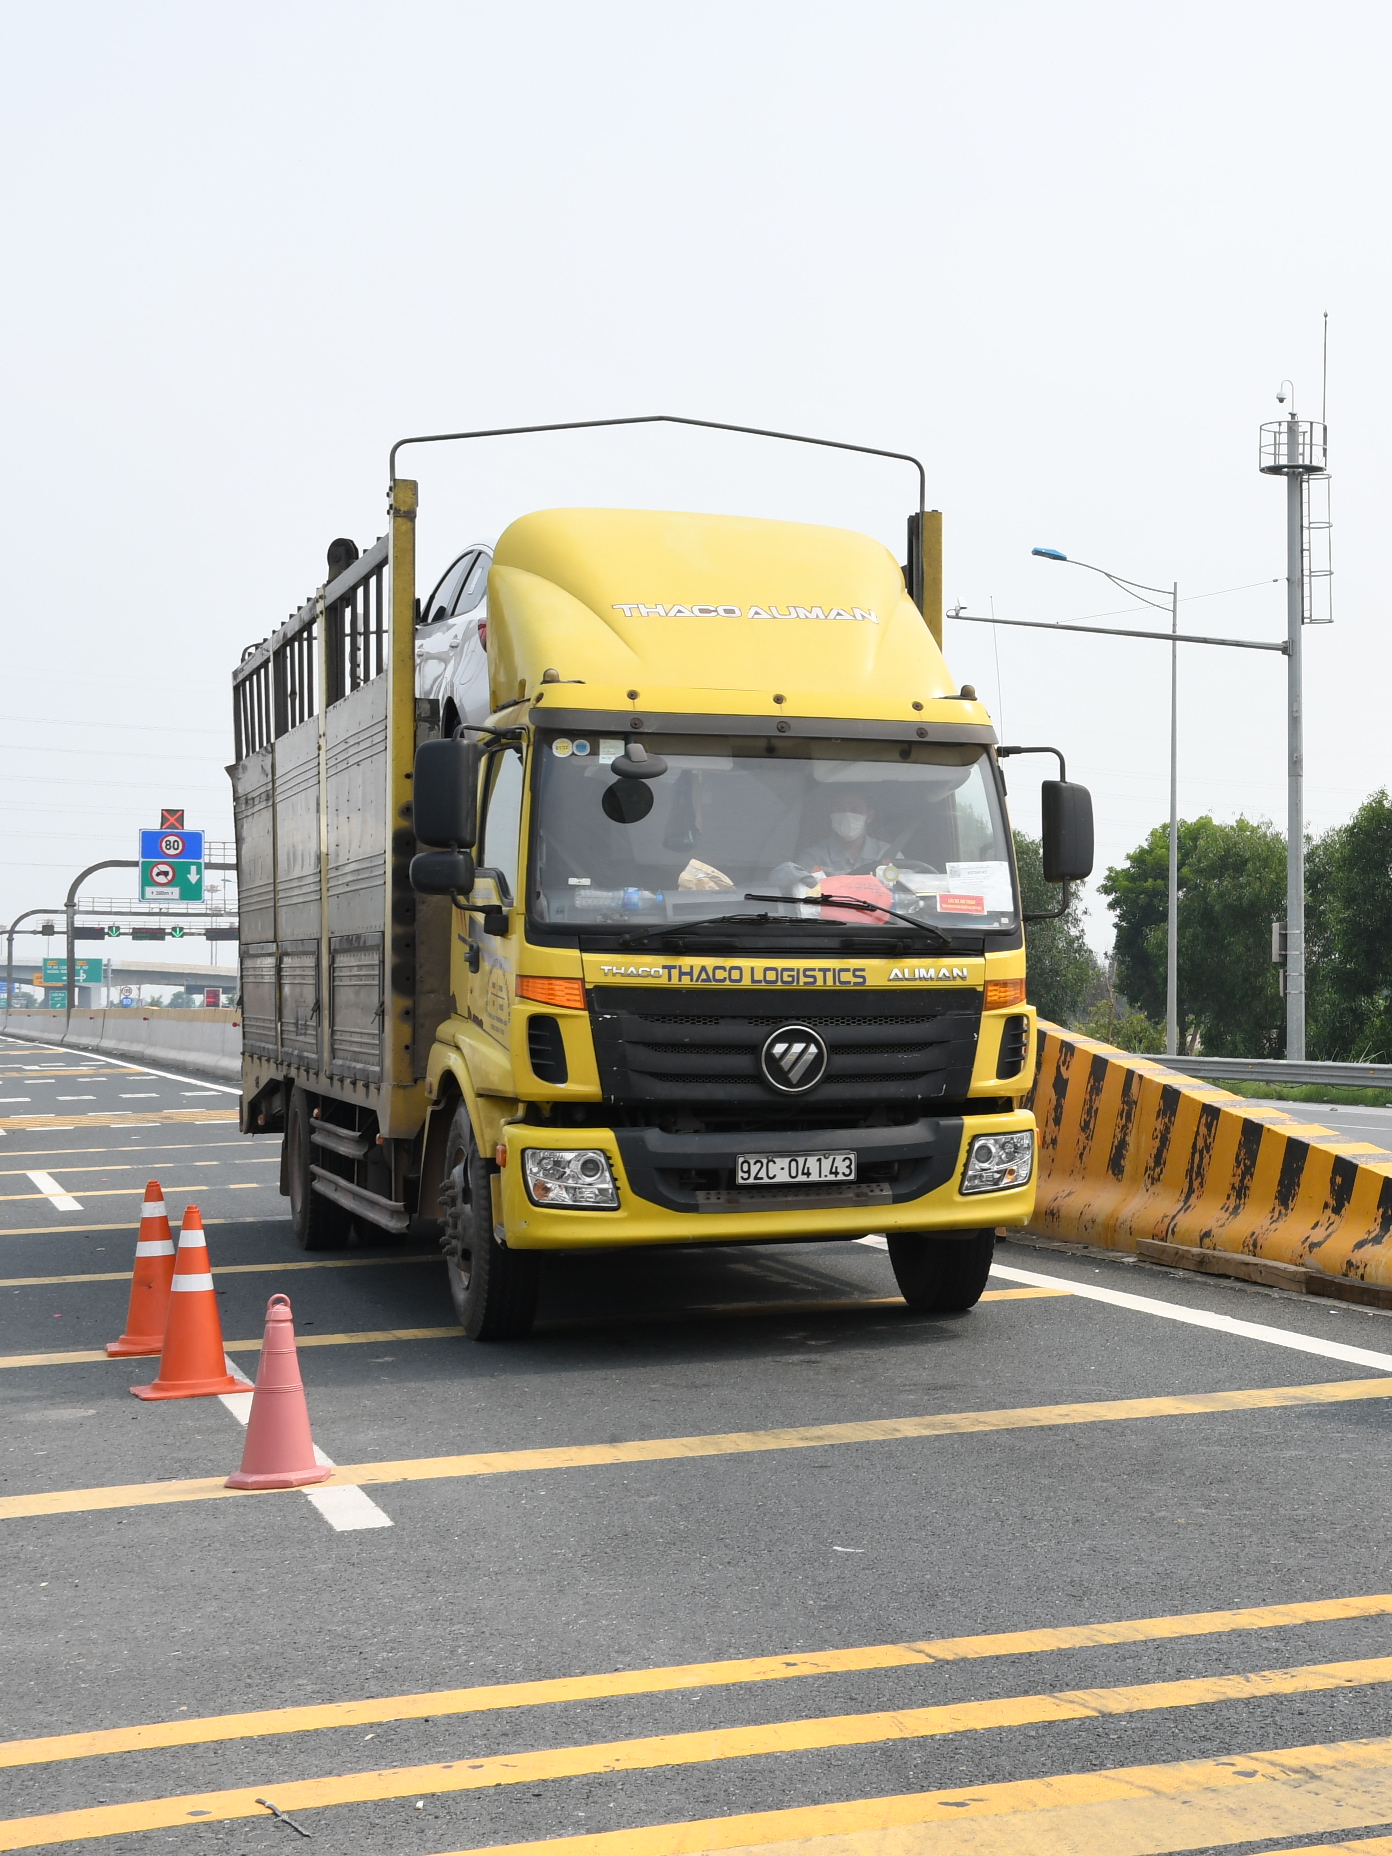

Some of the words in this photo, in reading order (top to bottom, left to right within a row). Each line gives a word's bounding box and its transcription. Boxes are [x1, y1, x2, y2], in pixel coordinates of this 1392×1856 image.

[612, 604, 742, 617] THACO
[747, 605, 879, 624] AUMAN
[164, 839, 180, 851] 80
[600, 965, 663, 978] THACO
[662, 965, 743, 983] THACO
[750, 966, 867, 985] LOGISTICS
[887, 967, 968, 982] AUMAN
[740, 1157, 853, 1181] 92C-041.43
